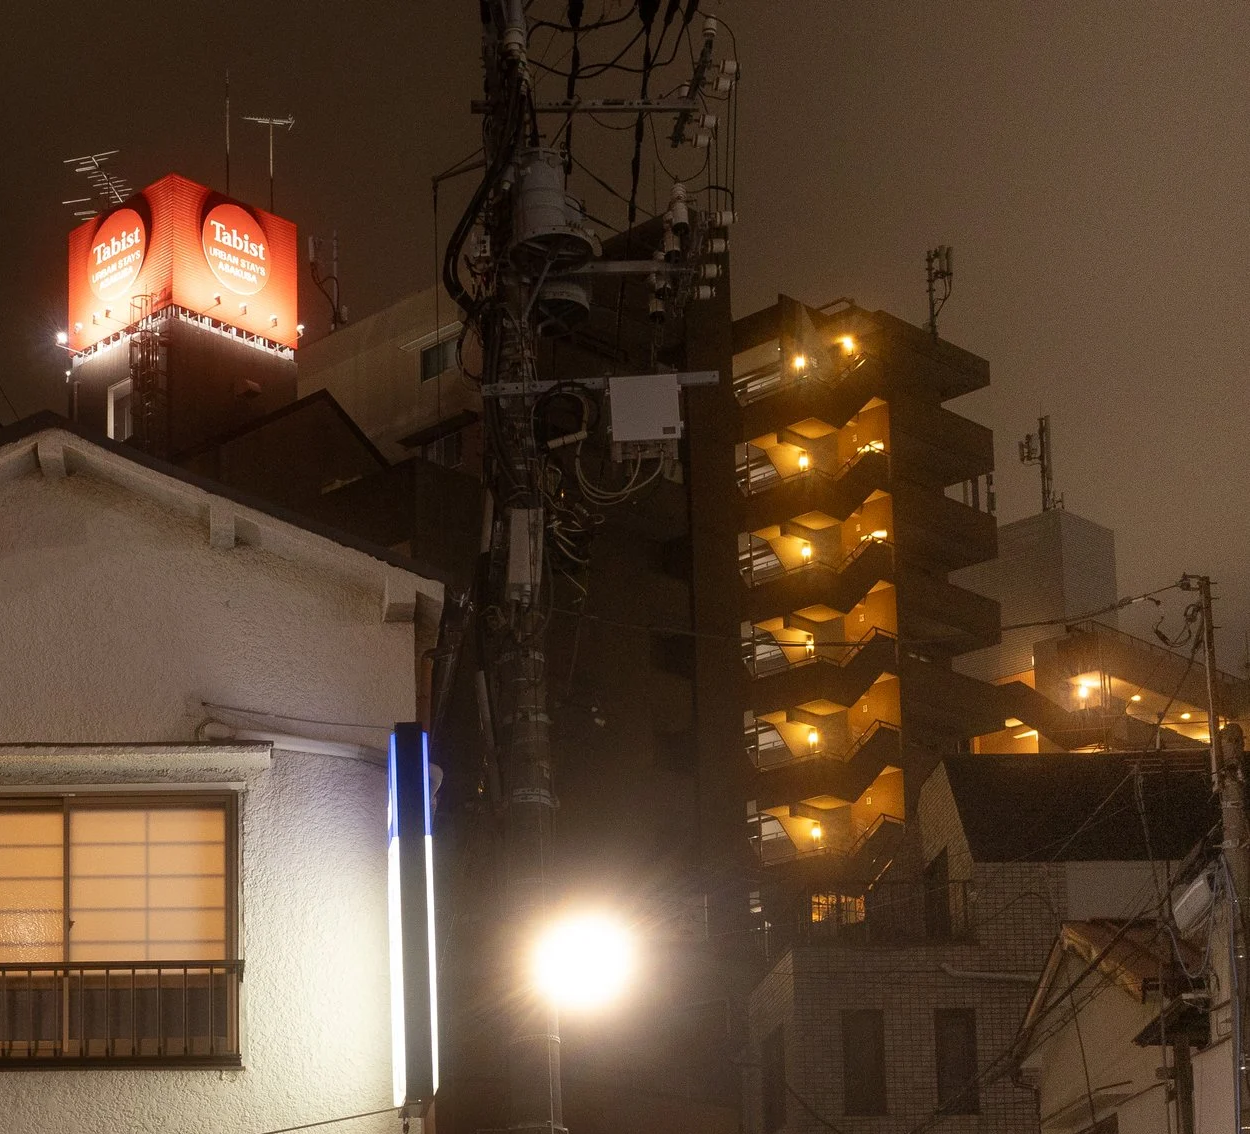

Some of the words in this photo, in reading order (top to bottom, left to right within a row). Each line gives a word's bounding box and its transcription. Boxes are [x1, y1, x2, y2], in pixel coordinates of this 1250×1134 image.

[93, 227, 141, 265] Tabist
[210, 220, 266, 261] Tabist
[118, 250, 141, 269] STAYS
[209, 246, 239, 266] URBAN
[240, 258, 266, 277] STAYS
